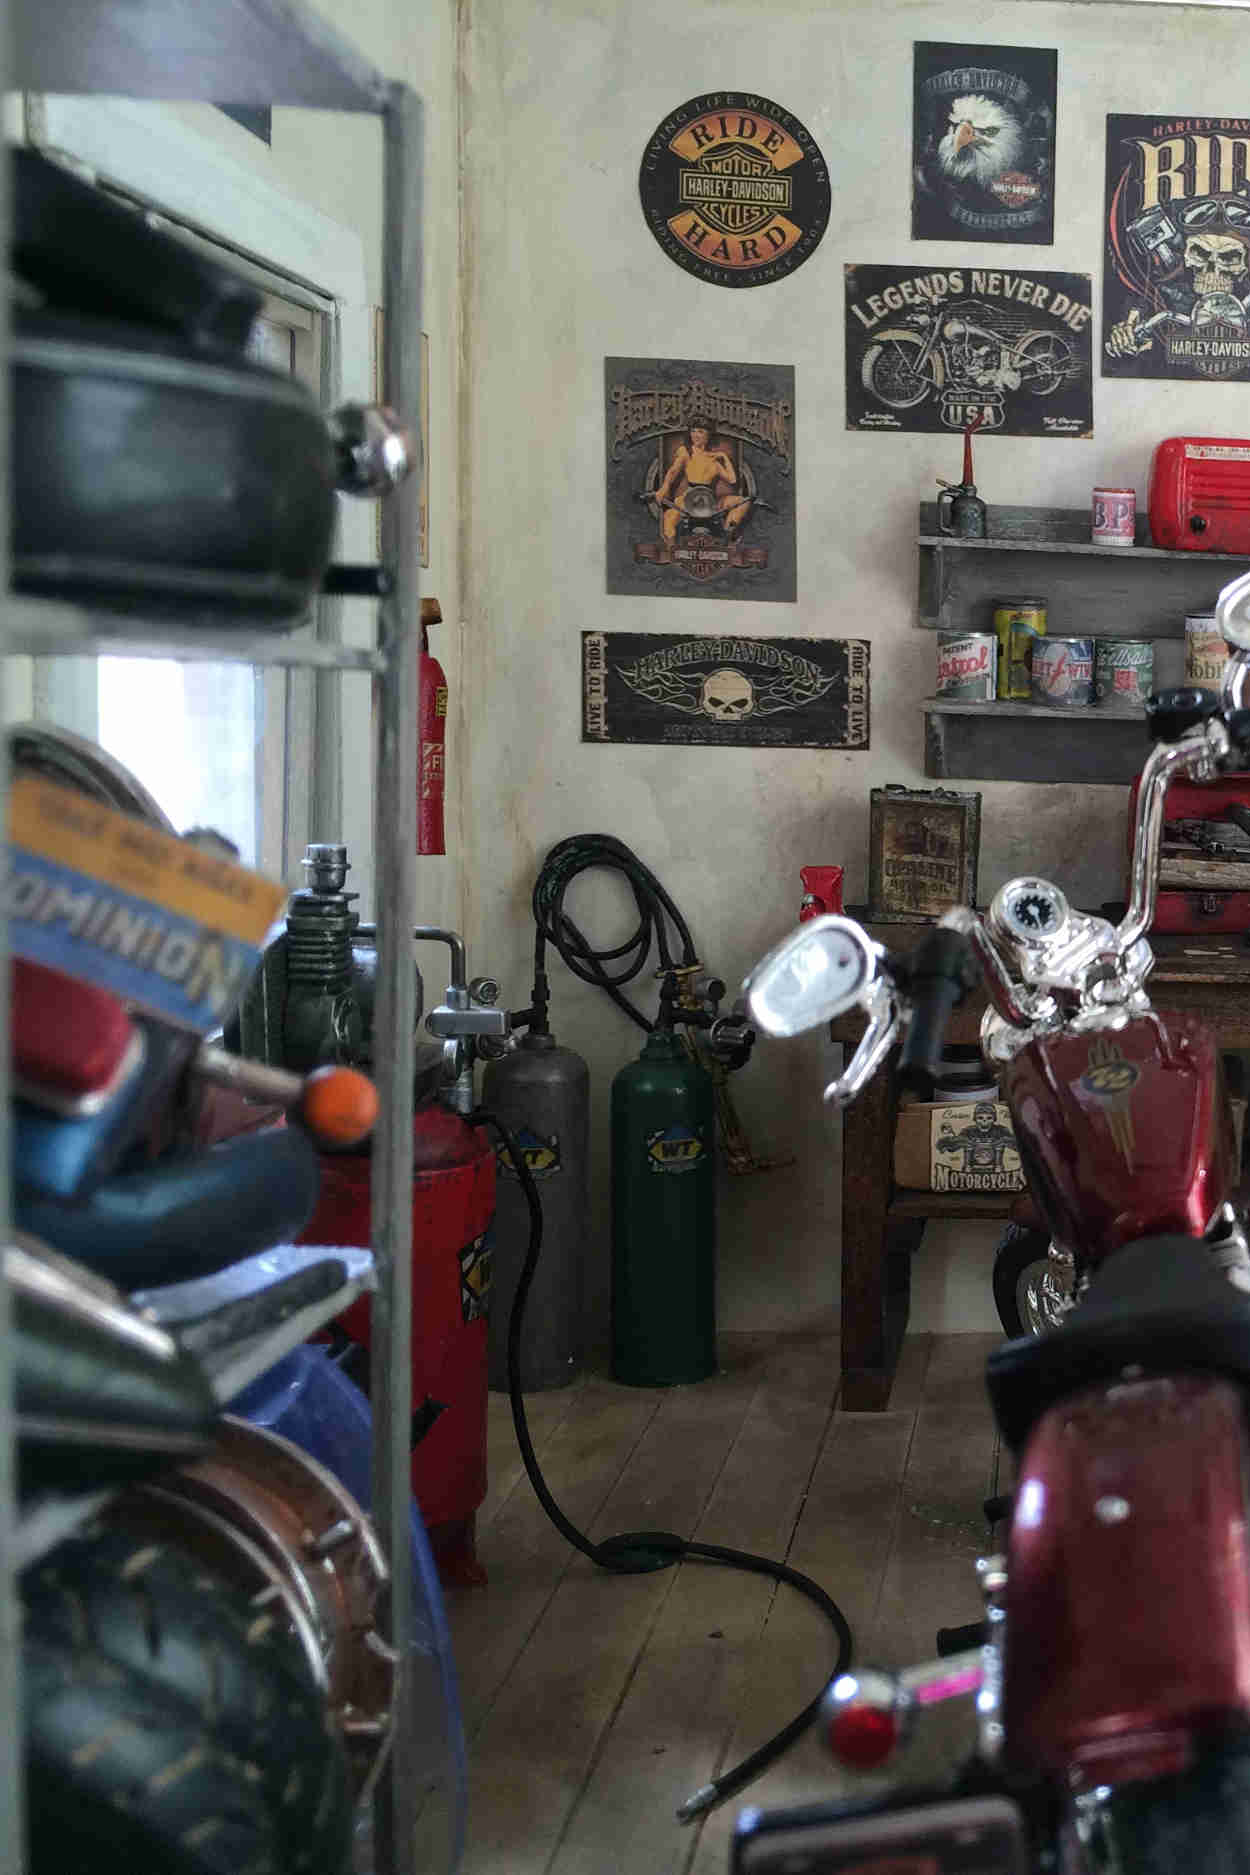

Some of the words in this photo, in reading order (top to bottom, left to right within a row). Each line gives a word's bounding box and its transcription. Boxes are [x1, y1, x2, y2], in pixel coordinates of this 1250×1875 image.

[689, 116, 784, 154] RIDE
[711, 160, 761, 176] MOTOR
[688, 178, 785, 202] HARLEY-DAVIDSON
[710, 203, 761, 227] CYCLES
[683, 225, 787, 261] HARD
[851, 271, 964, 328] LEGENDS
[971, 271, 1050, 310] NEVER
[1049, 293, 1093, 331] DIE
[588, 639, 601, 665] RIDE
[851, 646, 865, 678] RIDE
[589, 671, 601, 690] TO
[851, 686, 865, 704] TO
[589, 702, 601, 735] LIVE
[851, 708, 865, 740] LIVE
